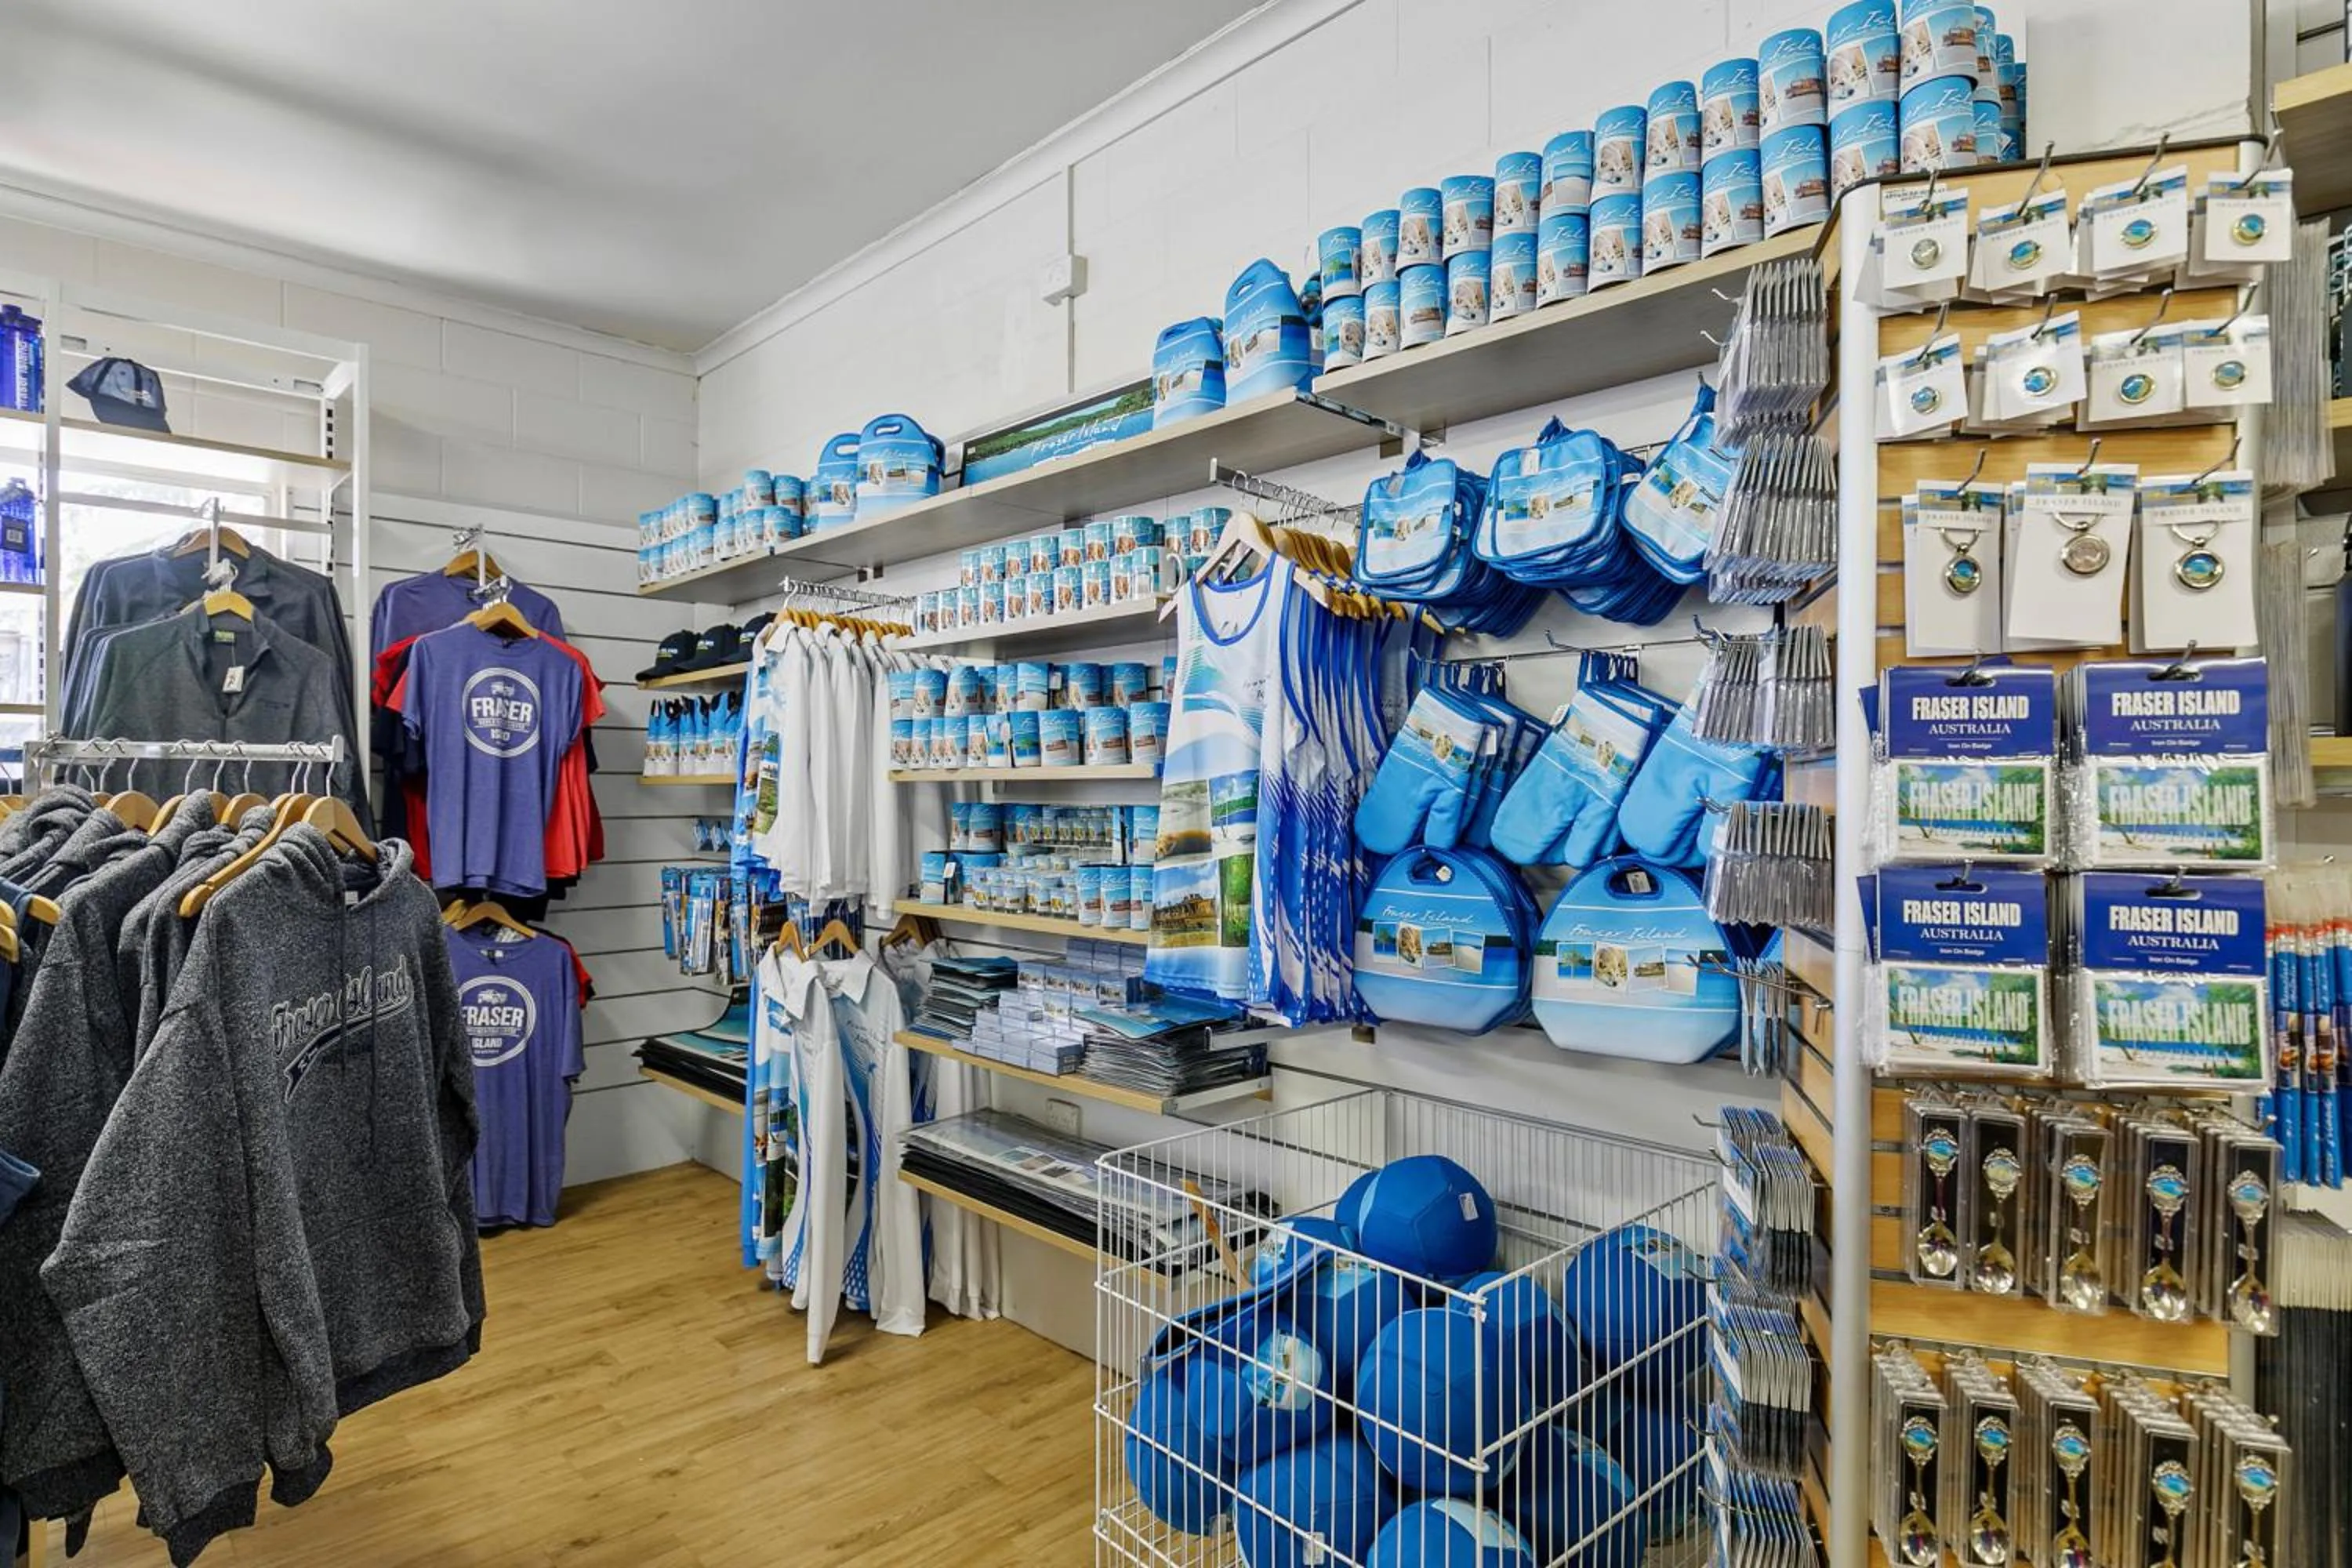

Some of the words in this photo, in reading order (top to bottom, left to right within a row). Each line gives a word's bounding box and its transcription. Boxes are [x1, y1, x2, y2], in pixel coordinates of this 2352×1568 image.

[1912, 696, 1969, 720] FRASER
[1972, 695, 2030, 720] ISLAND
[2111, 692, 2175, 716] FRASER
[2177, 690, 2241, 716] ISLAND
[1929, 723, 2011, 735] AUSTRALIA
[2130, 718, 2221, 731] AUSTRALIA
[1382, 904, 1417, 917] Fraser
[1420, 909, 1474, 924] Island
[1903, 899, 1961, 925] FRASER
[1963, 902, 2021, 927] ISLAND
[2109, 905, 2173, 932] FRASER
[2176, 908, 2239, 936] ISLAND
[1569, 923, 1624, 937] Fraser
[1628, 927, 1688, 940] Island
[1921, 927, 2004, 941] AUSTRALIA
[2128, 935, 2220, 950] AUSTRALIA
